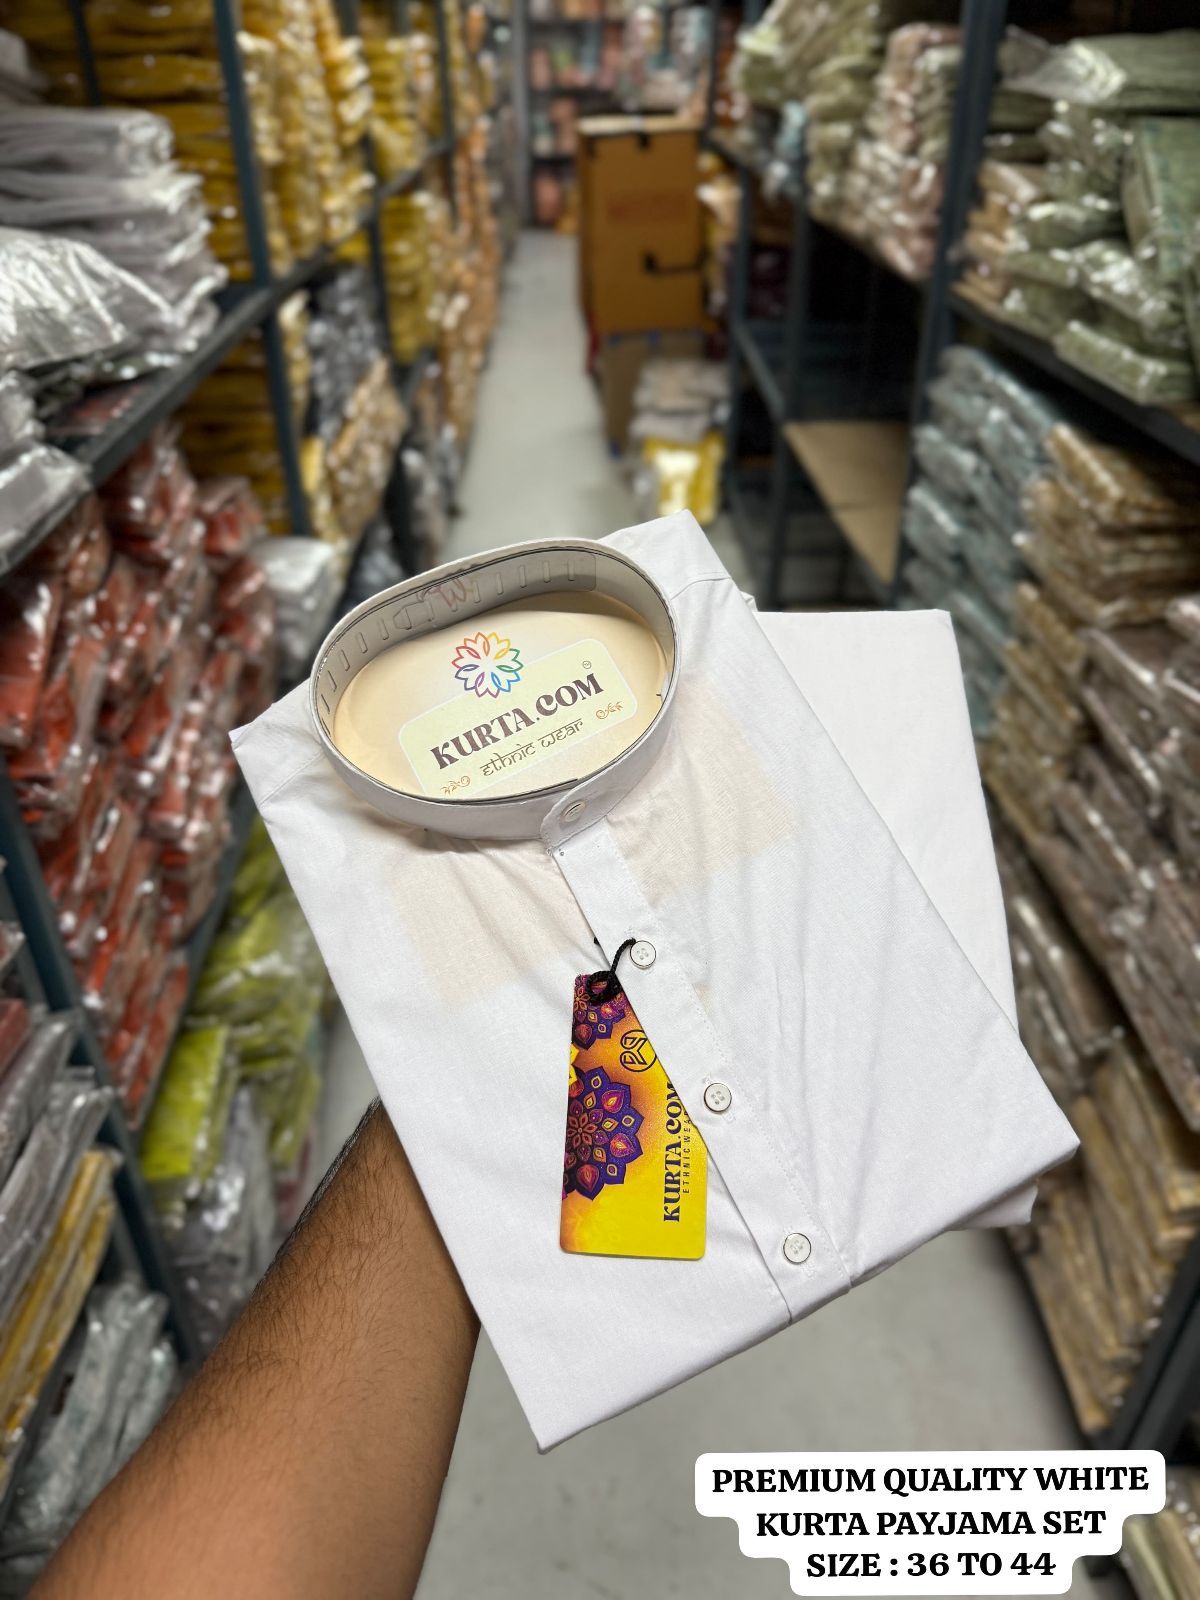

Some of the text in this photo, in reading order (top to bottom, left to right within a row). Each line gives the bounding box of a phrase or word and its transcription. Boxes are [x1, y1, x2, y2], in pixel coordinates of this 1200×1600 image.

[430, 673, 603, 769] KURTA.COM
[480, 718, 583, 776] ethnic wear
[682, 1148, 690, 1194] ETHNIC
